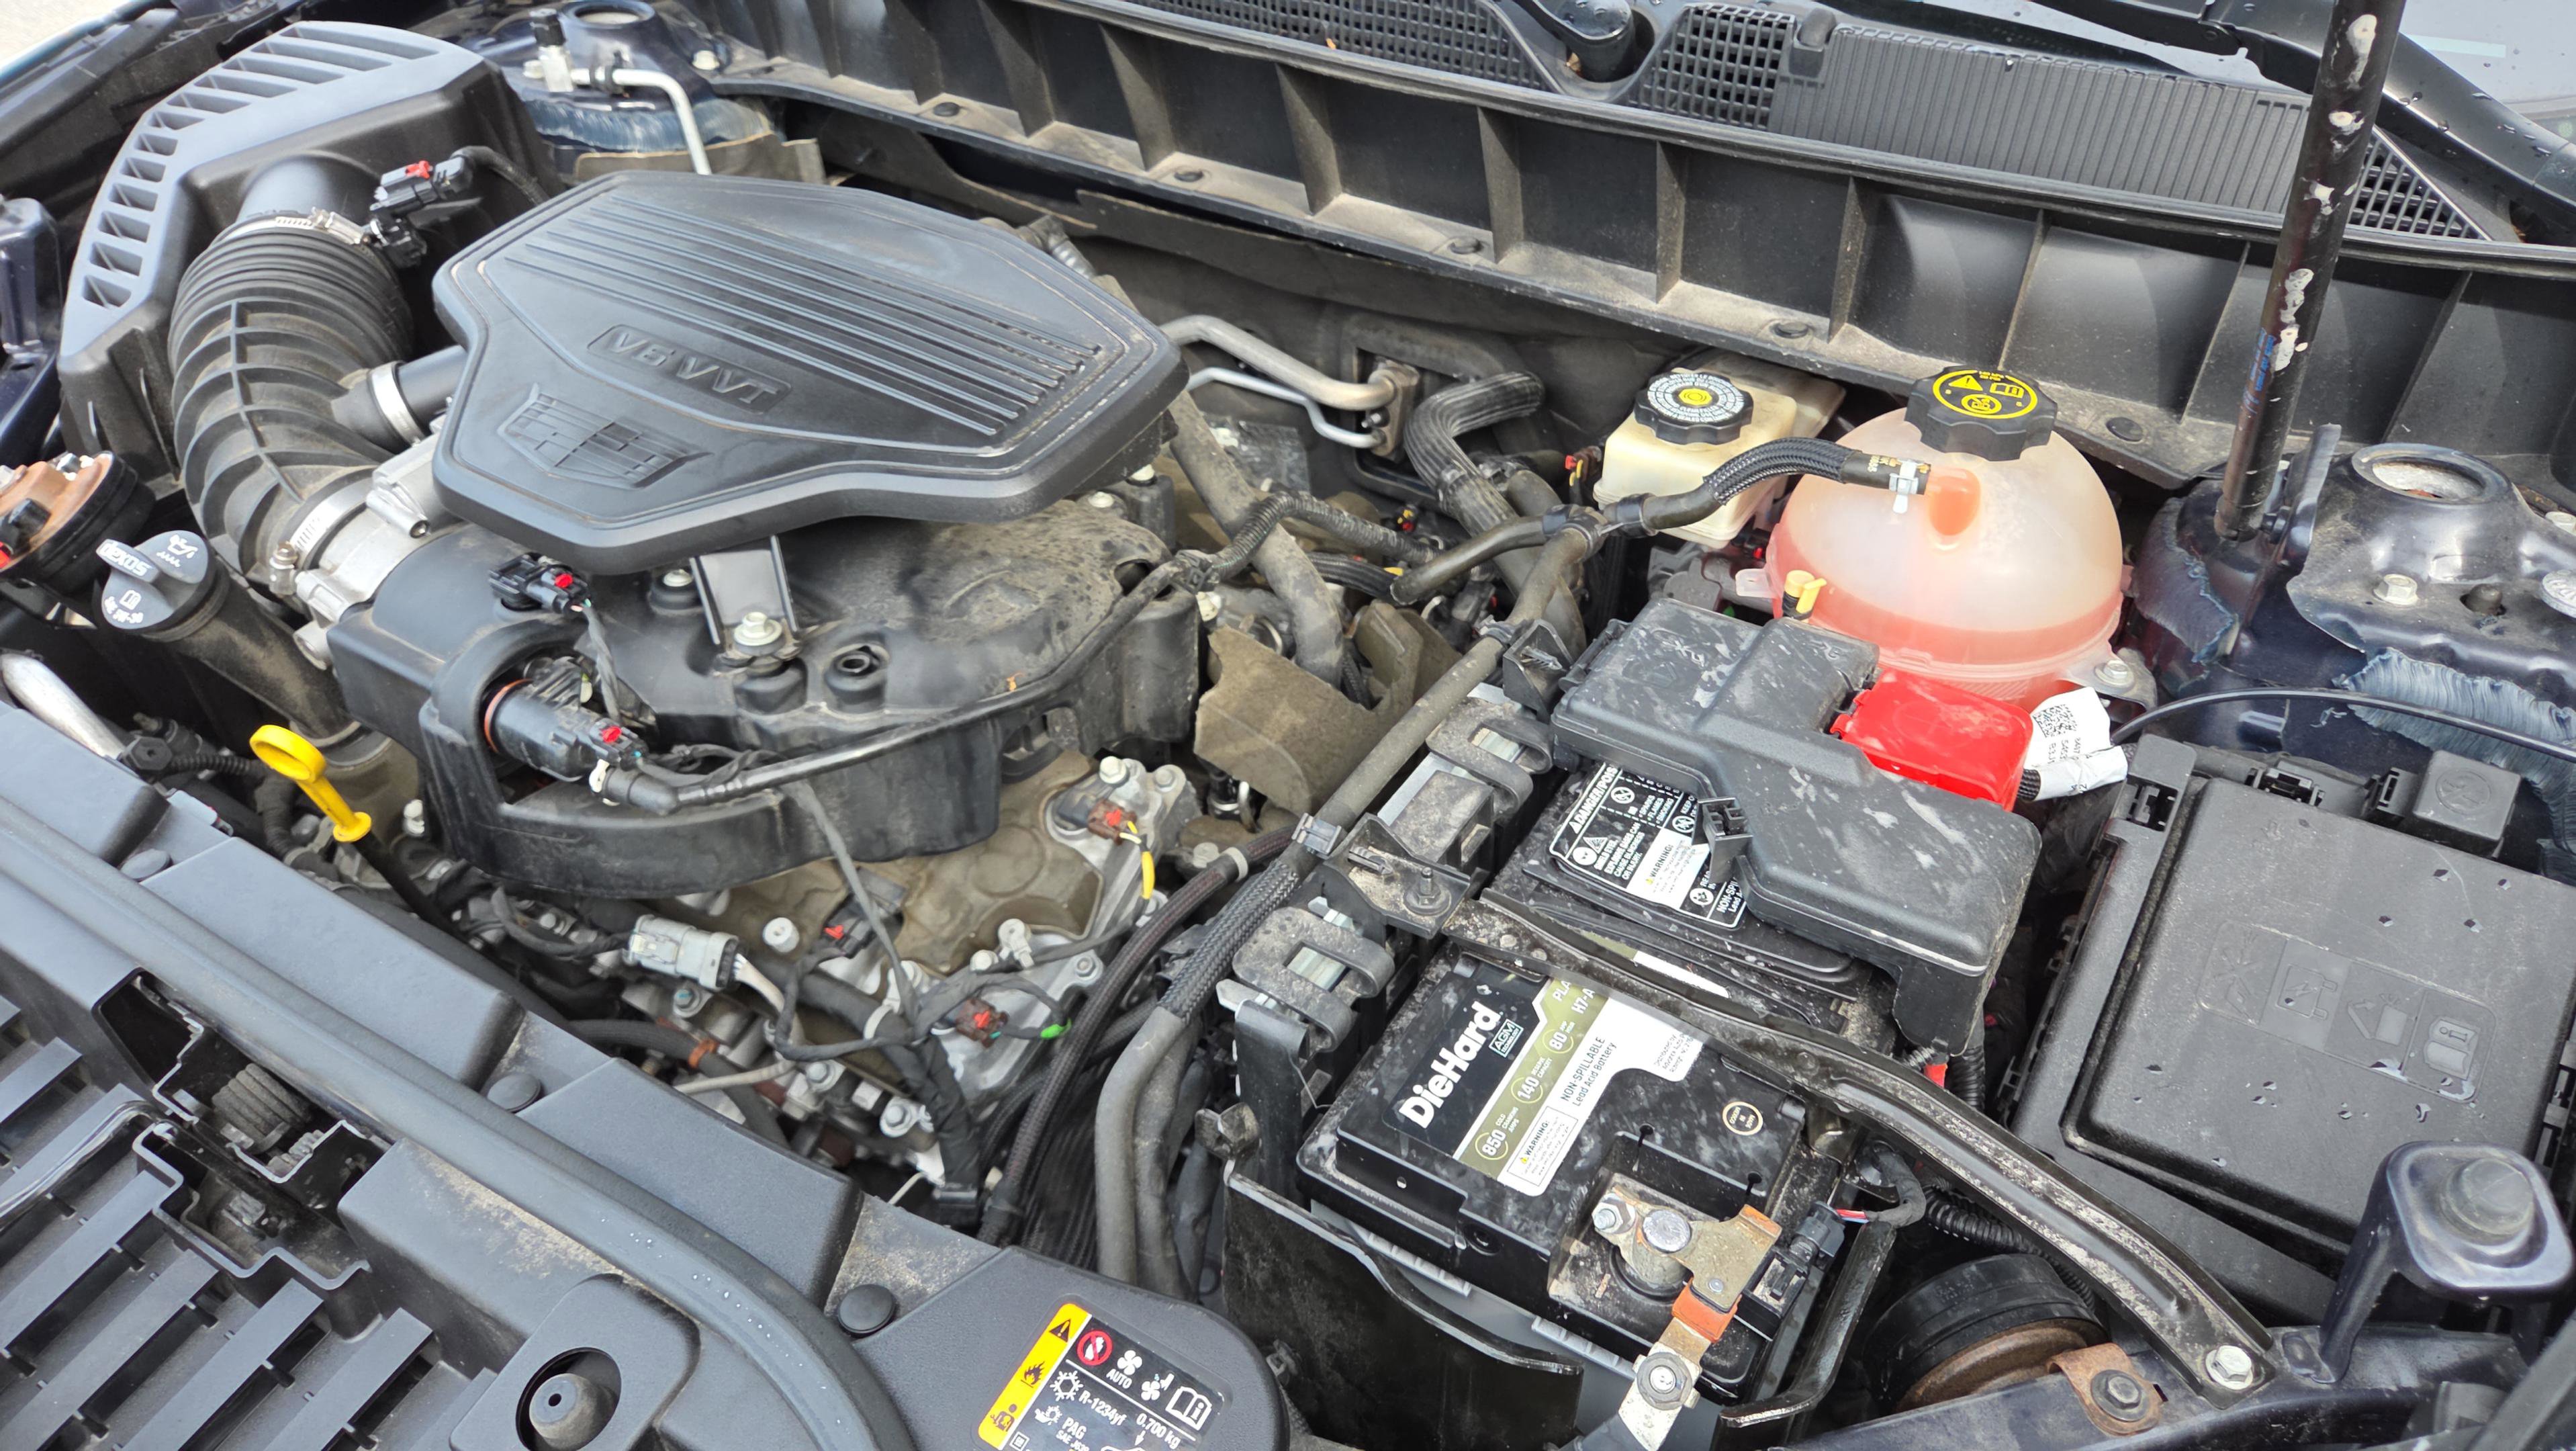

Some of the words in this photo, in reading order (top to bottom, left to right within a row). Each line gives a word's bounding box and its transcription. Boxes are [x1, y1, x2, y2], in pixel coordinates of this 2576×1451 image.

[608, 332, 676, 366] V6
[676, 353, 781, 404] VVT
[100, 541, 154, 576] dexos
[1574, 766, 1618, 827] DANGER/POIS
[1639, 795, 1655, 815] SPARKS
[1647, 797, 1664, 818] FLAMES
[1657, 798, 1674, 822] SMOKING
[1630, 822, 1641, 834] CAN
[1614, 858, 1629, 877] CAUSE
[1624, 832, 1645, 859] BLINDNESS
[1650, 844, 1673, 877] WARNING:
[1495, 1022, 1515, 1051] AGM
[1549, 1032, 1568, 1050] 80
[1398, 1001, 1501, 1129] DieHard
[1561, 1037, 1605, 1101] NON-SPILLABLE
[1573, 1086, 1588, 1106] Lead
[1588, 1071, 1599, 1088] Acid
[1594, 1042, 1617, 1071] Battery
[1518, 1076, 1539, 1099] 140
[1482, 1129, 1506, 1156] 850
[1525, 1120, 1549, 1156] WARNING:
[1105, 1368, 1132, 1389] AUTO
[1078, 1390, 1128, 1426] R-1234yf
[1055, 1430, 1072, 1444] SAE
[1062, 1417, 1087, 1440] PAG
[1136, 1413, 1168, 1439] 0.700
[1162, 1432, 1181, 1450] kg
